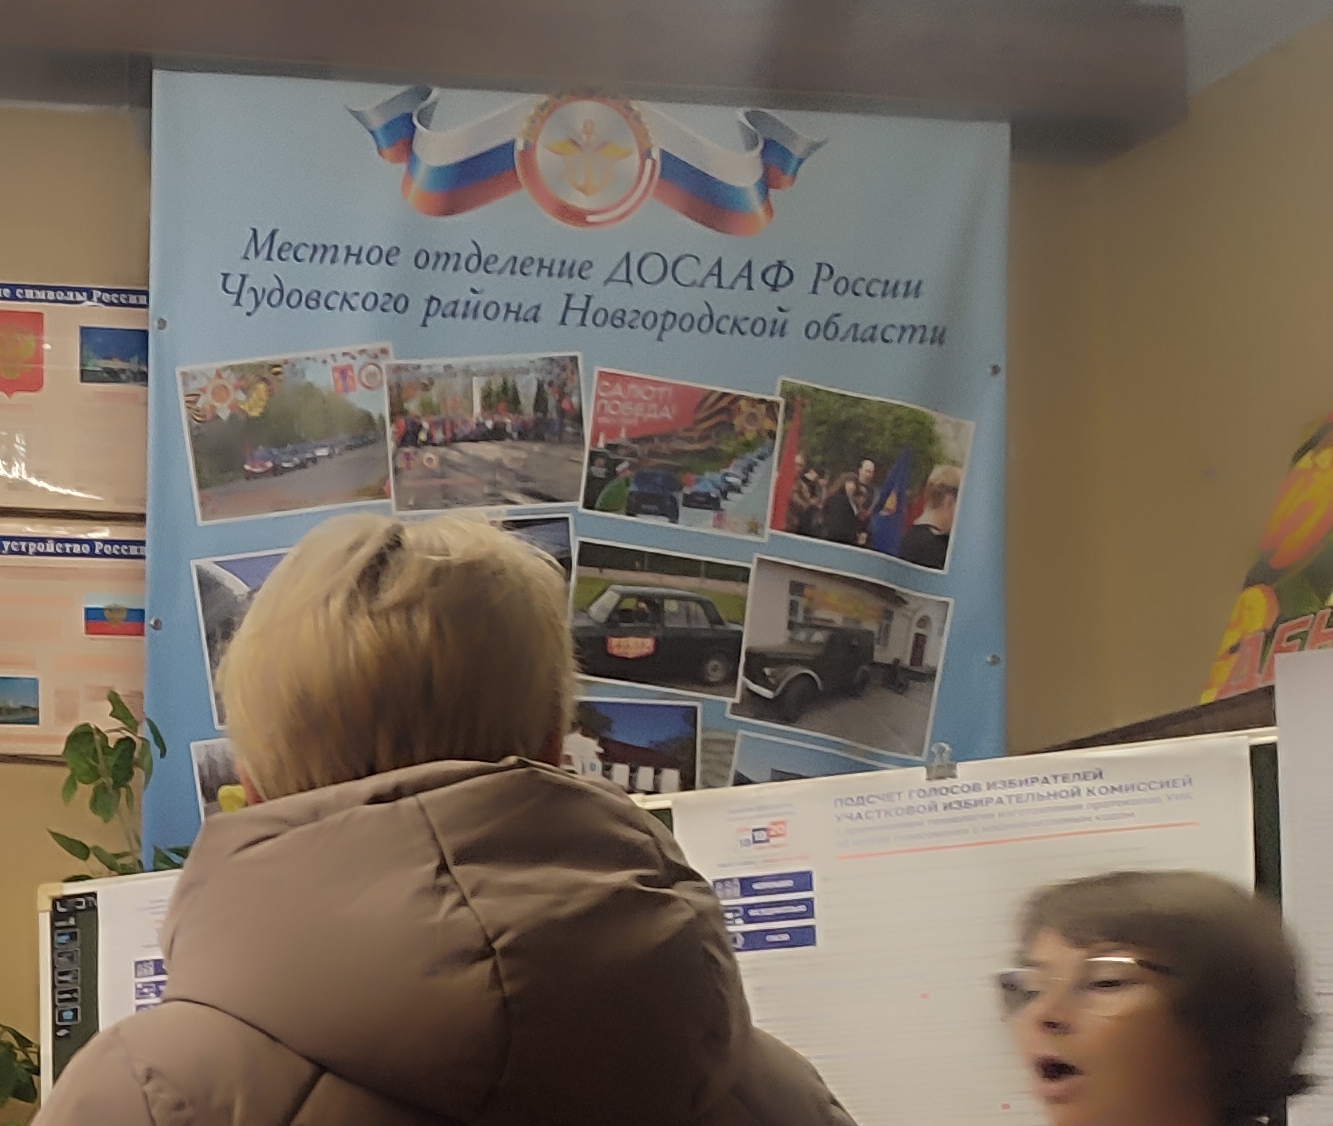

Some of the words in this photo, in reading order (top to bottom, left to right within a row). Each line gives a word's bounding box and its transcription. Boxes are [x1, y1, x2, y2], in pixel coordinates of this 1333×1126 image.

[241, 227, 401, 268] Местное
[413, 240, 594, 281] отделение
[603, 251, 794, 293] ДОСААФ
[808, 261, 924, 300] России
[15, 287, 88, 302] символы
[91, 289, 149, 305] России
[220, 272, 410, 318] Чудовского
[420, 287, 541, 328] района
[558, 293, 789, 343] Новгородской
[804, 312, 947, 347] области
[2, 539, 91, 556] устройство
[93, 540, 146, 556] России
[835, 801, 938, 822] УЧАСТКОВОЙ
[943, 786, 1082, 812] ИЗБИРАТЕЛЬНОЙ
[1086, 775, 1194, 797] КОМИССИЕЙ
[908, 782, 982, 800] ГОЛОСОВ
[986, 768, 1104, 792] ИЗБИРАТЕЛЕЙ
